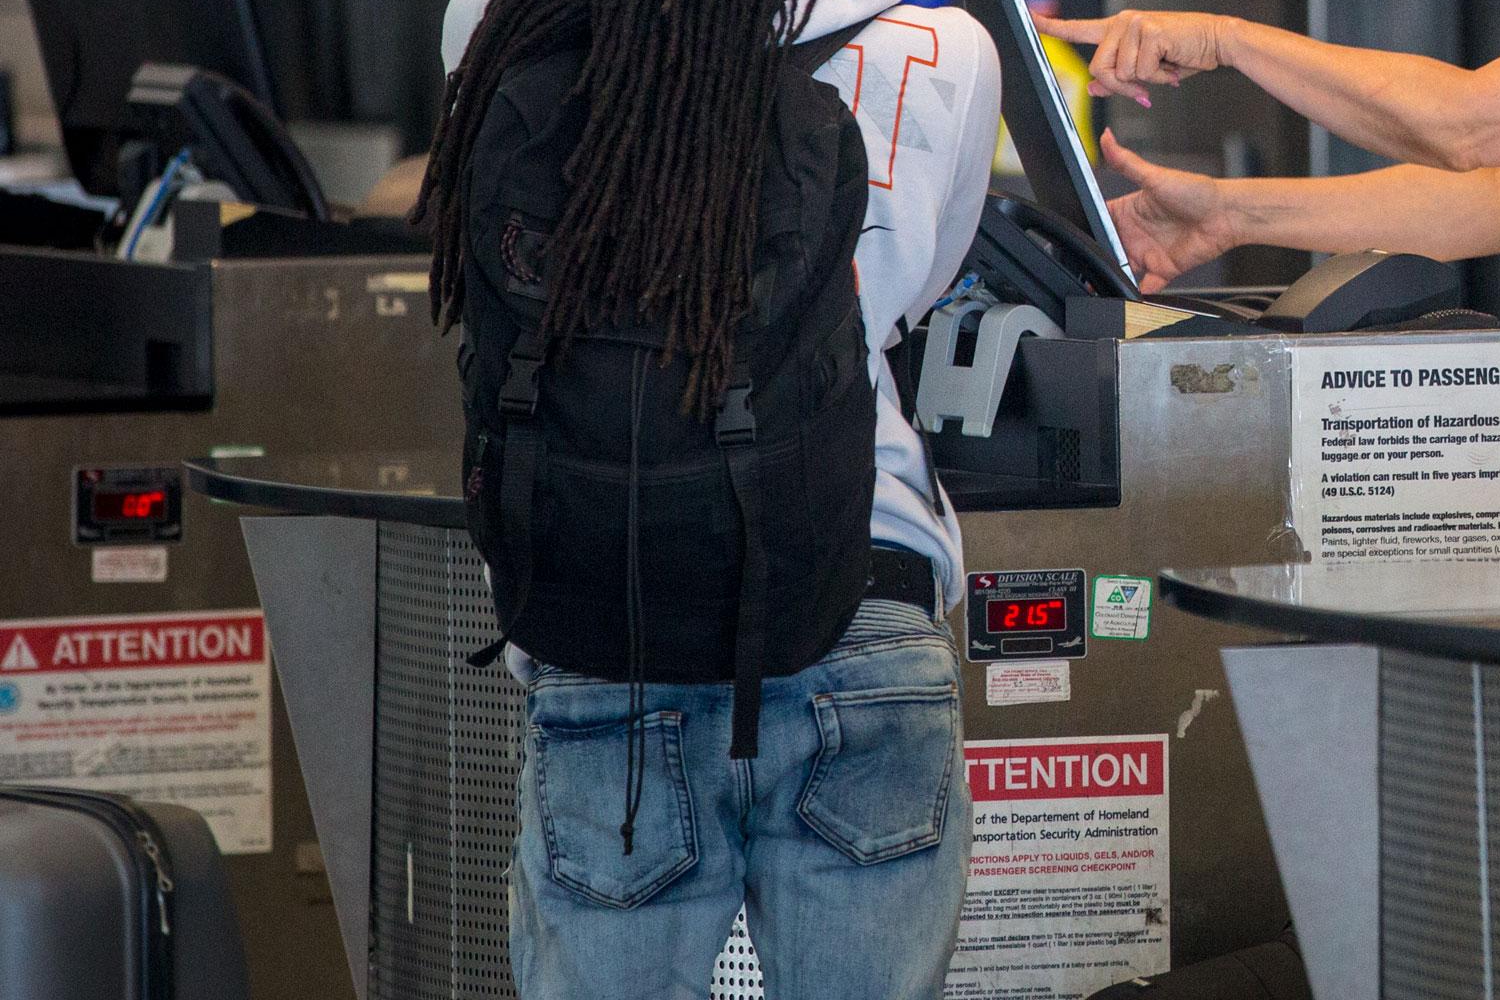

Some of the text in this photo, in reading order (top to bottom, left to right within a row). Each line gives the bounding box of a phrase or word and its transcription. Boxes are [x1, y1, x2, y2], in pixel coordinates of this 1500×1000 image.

[1320, 370, 1387, 389] ADVICE
[1389, 369, 1414, 387] TO
[1322, 417, 1413, 431] Transportation
[1418, 415, 1429, 428] of
[1434, 415, 1499, 428] Hazardous
[1322, 434, 1355, 447] Federal
[1358, 437, 1375, 446] law
[1377, 435, 1410, 445] forbids
[1412, 435, 1427, 444] the
[1429, 434, 1467, 444] carriage
[1469, 433, 1479, 443] of
[1321, 450, 1444, 462] luggage or on your person.
[1321, 473, 1328, 483] A
[1330, 473, 1370, 482] violation
[1373, 474, 1390, 482] can
[1392, 471, 1419, 481] result
[1421, 471, 1430, 480] in
[1432, 470, 1449, 480] five
[1451, 471, 1476, 480] years
[1321, 486, 1395, 499] (49 U.S.C. 5124)
[1322, 514, 1362, 523] Hazardous
[1364, 513, 1400, 521] materials
[1402, 512, 1430, 520] include
[1432, 511, 1474, 521] explosives,
[1322, 526, 1354, 535] poisons,
[1356, 525, 1395, 533] corrosives
[1398, 524, 1412, 532] and
[1414, 523, 1456, 532] radioactive
[1458, 522, 1496, 530] materials.
[1322, 537, 1350, 546] Paints,
[1353, 537, 1378, 547] lighter
[1380, 536, 1400, 545] fluid,
[1403, 535, 1442, 544] fireworks,
[1444, 535, 1460, 543] tear
[1462, 535, 1488, 544] gases,
[1336, 548, 1367, 558] special
[1368, 547, 1414, 557] exceptions
[1415, 547, 1428, 555] for
[1429, 546, 1451, 555] small
[1452, 546, 1493, 555] quantities
[998, 572, 1078, 583] DIVISION SCALE
[52, 625, 250, 666] ATTENTION
[965, 753, 1148, 791] TTENTION
[975, 808, 1149, 825] of the Departement of Homeland
[972, 826, 1158, 844] ansportation Security Administration
[969, 849, 1154, 864] RICTIONS APPLY TO LIQUIDS, GELS, AND/OR
[974, 867, 1026, 876] PASSENGER
[1029, 865, 1078, 874] SCREENING
[1081, 862, 1135, 872] CHECKPOINT
